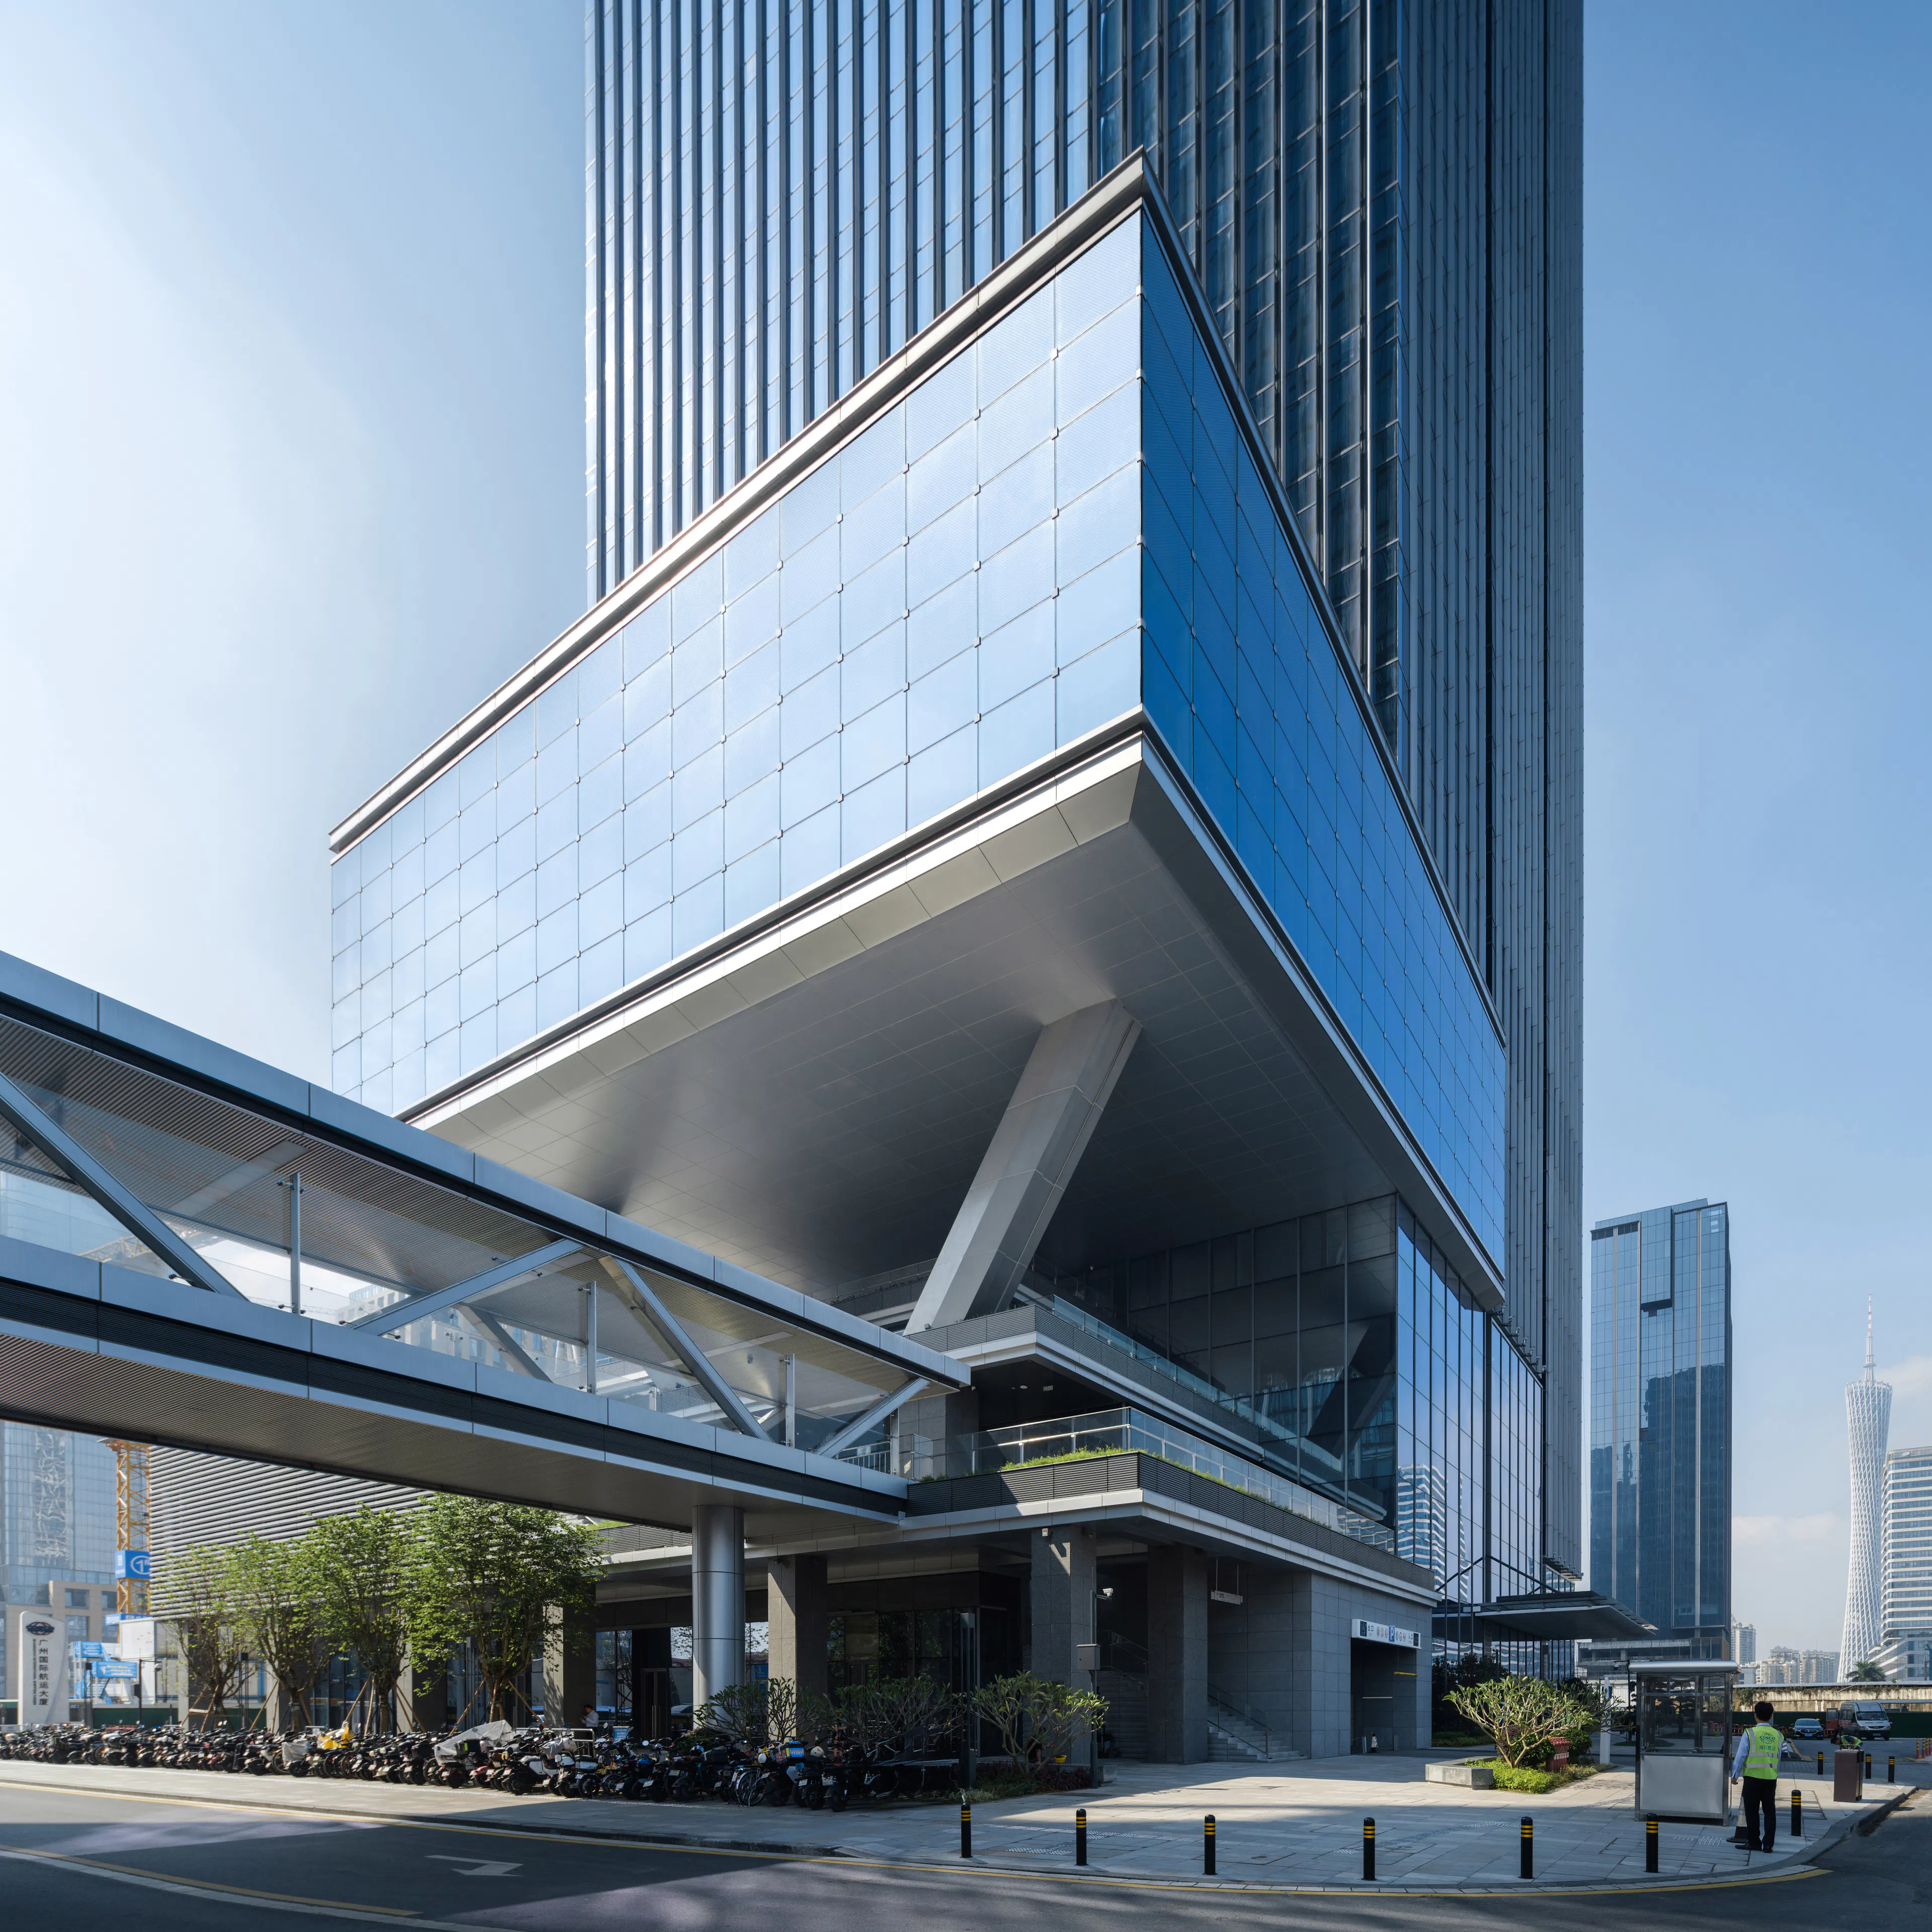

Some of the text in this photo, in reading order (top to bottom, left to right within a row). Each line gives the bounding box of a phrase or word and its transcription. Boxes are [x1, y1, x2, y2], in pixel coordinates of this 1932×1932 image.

[1390, 1627, 1394, 1640] P
[39, 1640, 48, 1705] 广州国际航运大厦
